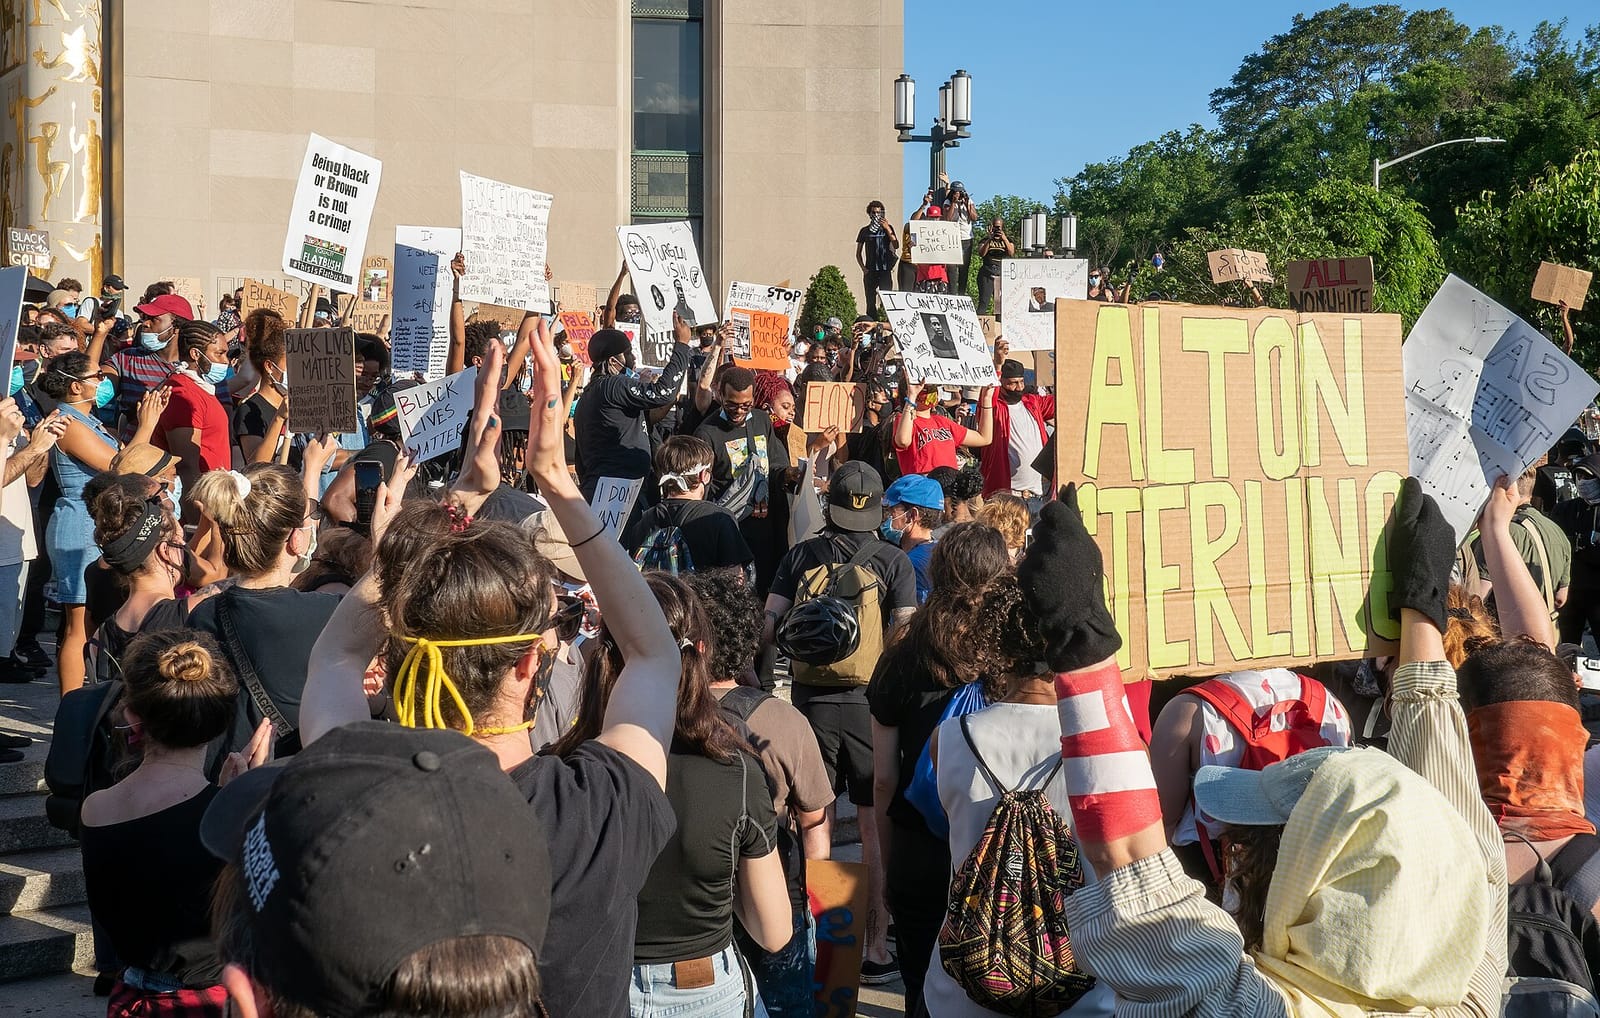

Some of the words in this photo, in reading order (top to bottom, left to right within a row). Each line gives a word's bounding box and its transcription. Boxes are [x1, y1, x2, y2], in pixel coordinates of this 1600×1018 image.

[312, 153, 341, 176] Being
[342, 163, 370, 184] Black
[314, 174, 326, 188] or
[327, 176, 358, 198] Brown
[318, 193, 330, 209] is
[331, 199, 348, 215] not
[308, 210, 316, 222] a
[317, 213, 352, 234] crime!
[11, 230, 47, 245] BLACK
[12, 242, 35, 254] LIVES
[302, 252, 342, 273] FLATBUSH
[1219, 254, 1261, 270] STOP
[1303, 260, 1358, 289] ALL
[250, 284, 289, 310] BLACK
[767, 287, 801, 302] STOP
[882, 293, 905, 311] I
[752, 314, 781, 330] FUCK
[285, 331, 320, 356] BLACK
[325, 330, 353, 356] LIVES
[302, 356, 346, 381] MATTER
[332, 386, 345, 402] SAY
[398, 380, 459, 416] BLACK
[1082, 306, 1370, 484] ALTON
[331, 400, 352, 416] THEIR
[808, 384, 866, 431] FLOYD
[330, 415, 354, 431] NAMES
[404, 403, 455, 437] LIVES
[408, 422, 463, 459] MATTER
